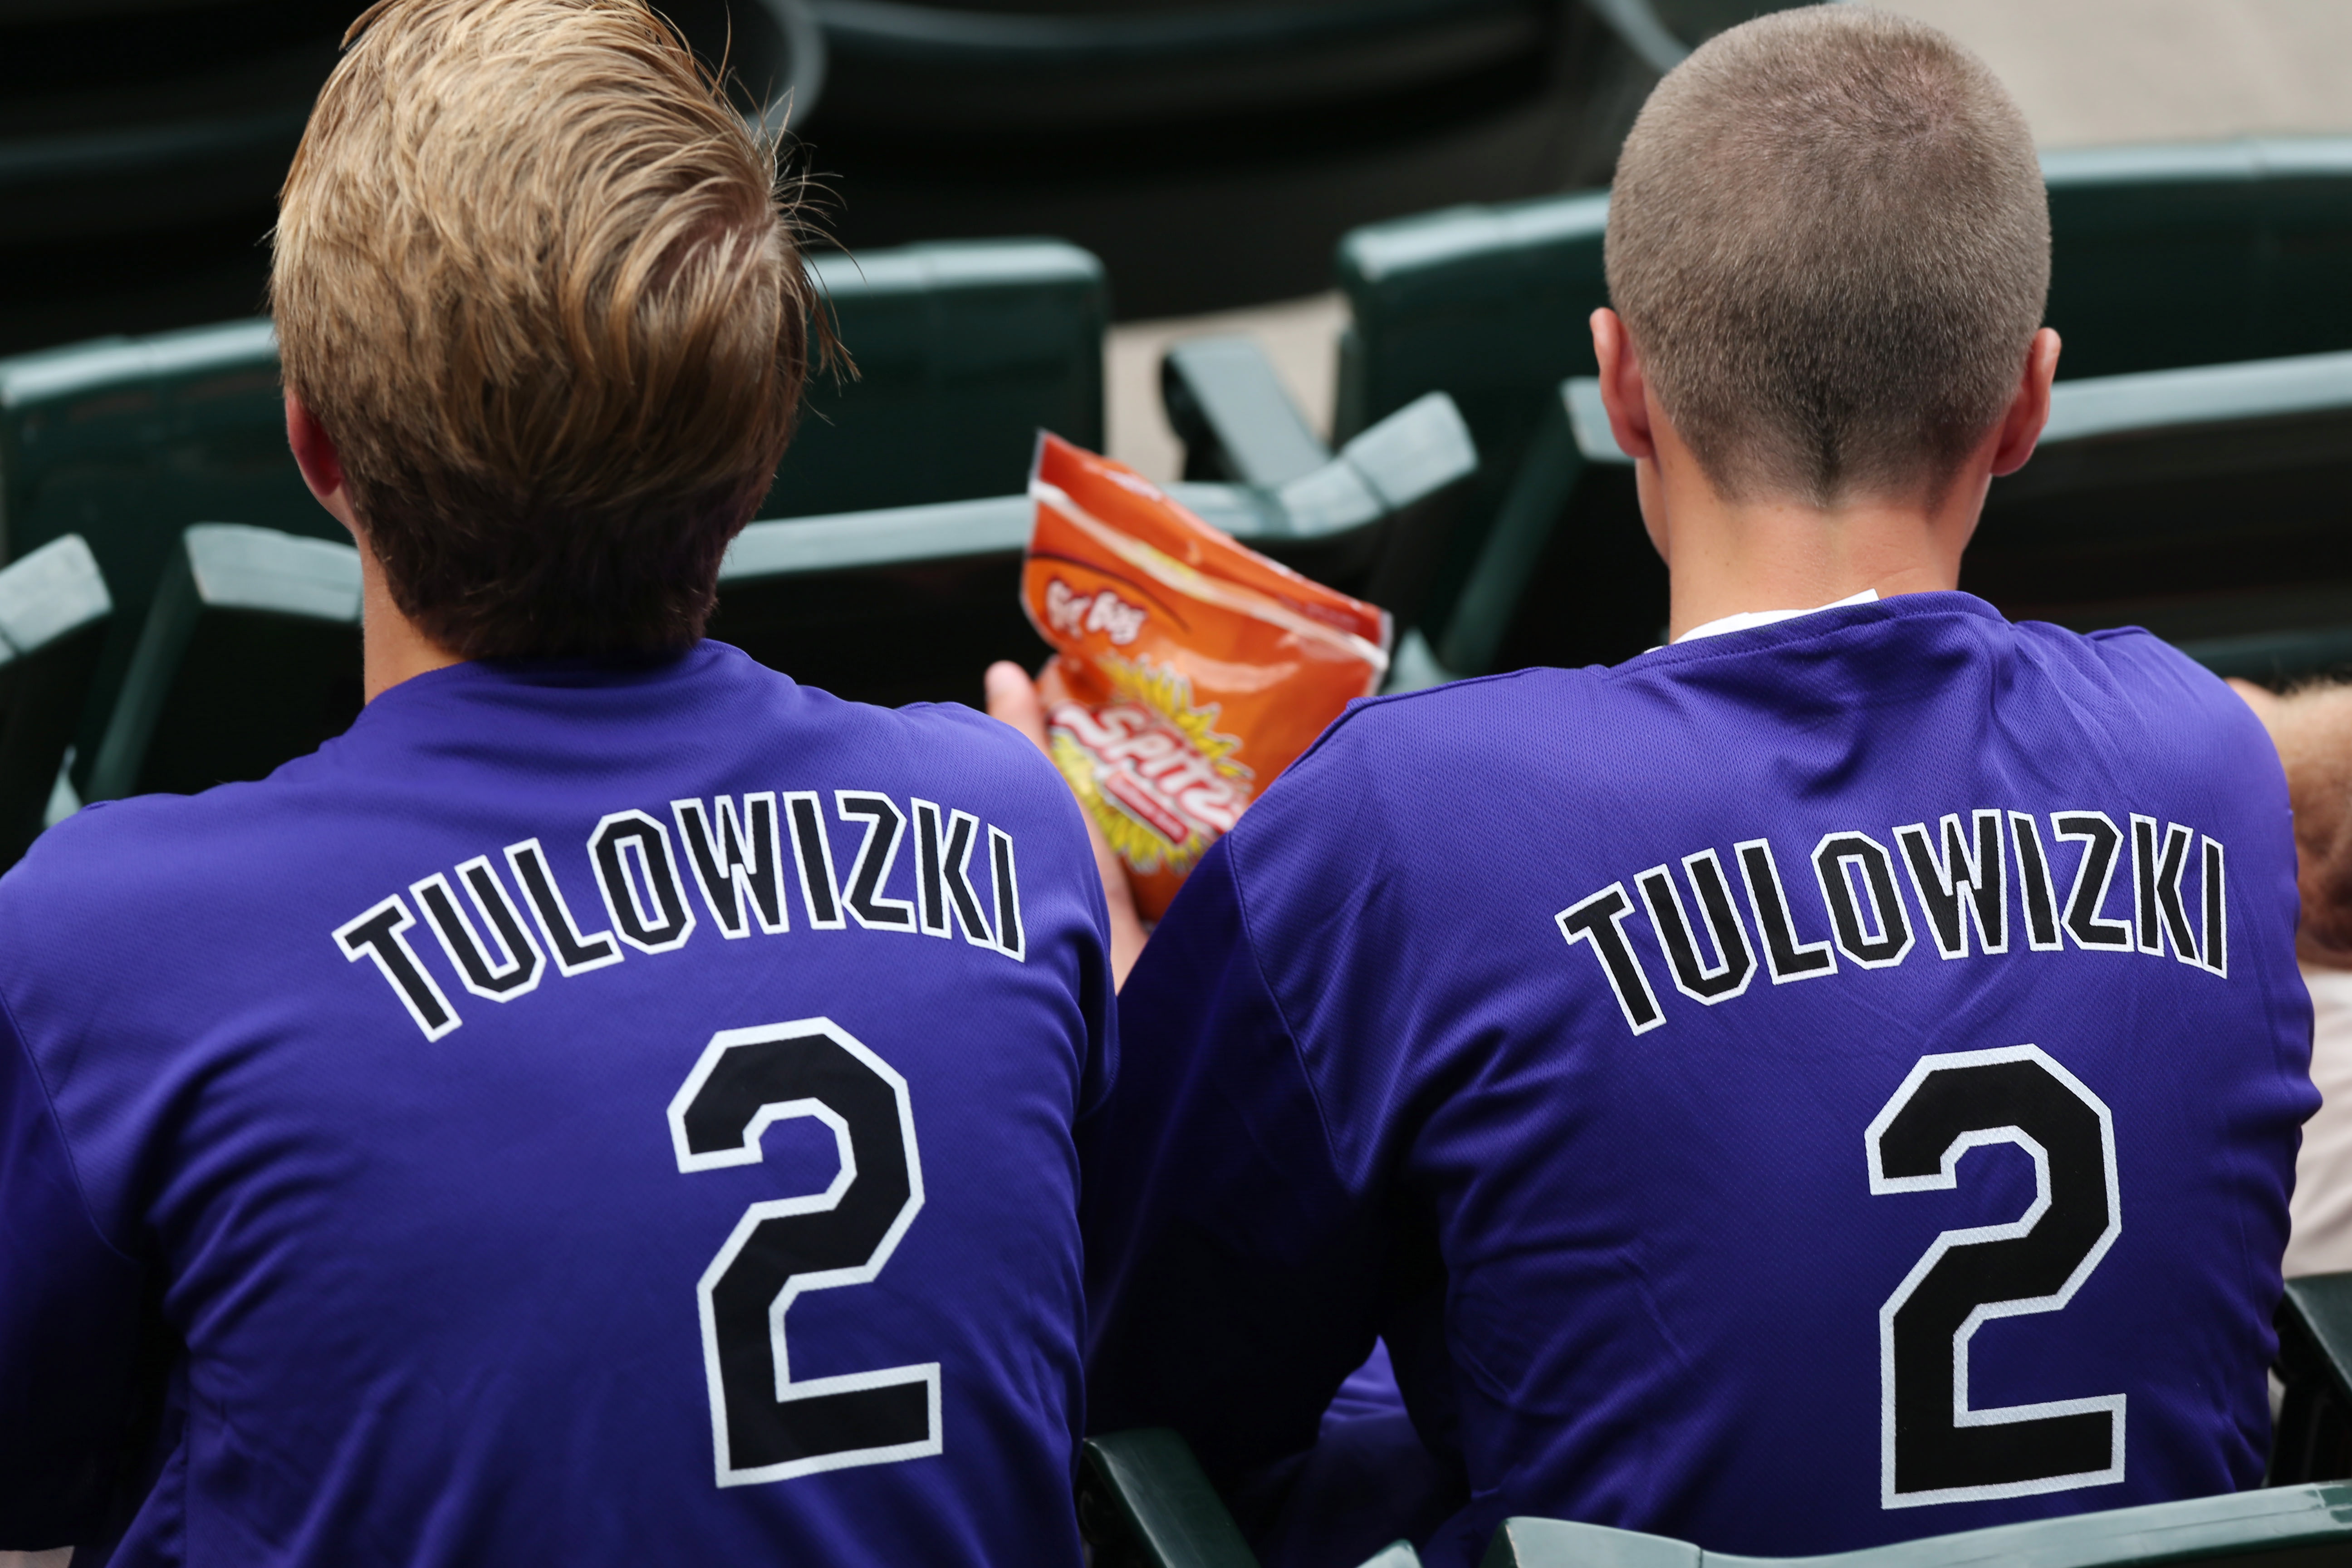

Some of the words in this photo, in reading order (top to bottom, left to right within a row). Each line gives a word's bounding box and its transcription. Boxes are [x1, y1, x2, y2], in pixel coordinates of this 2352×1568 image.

[332, 790, 1024, 1042] TULOWIZKI
[1554, 808, 2227, 1035] TULOWIZKI
[667, 1017, 942, 1488] 2
[1864, 1044, 2126, 1509] 2
